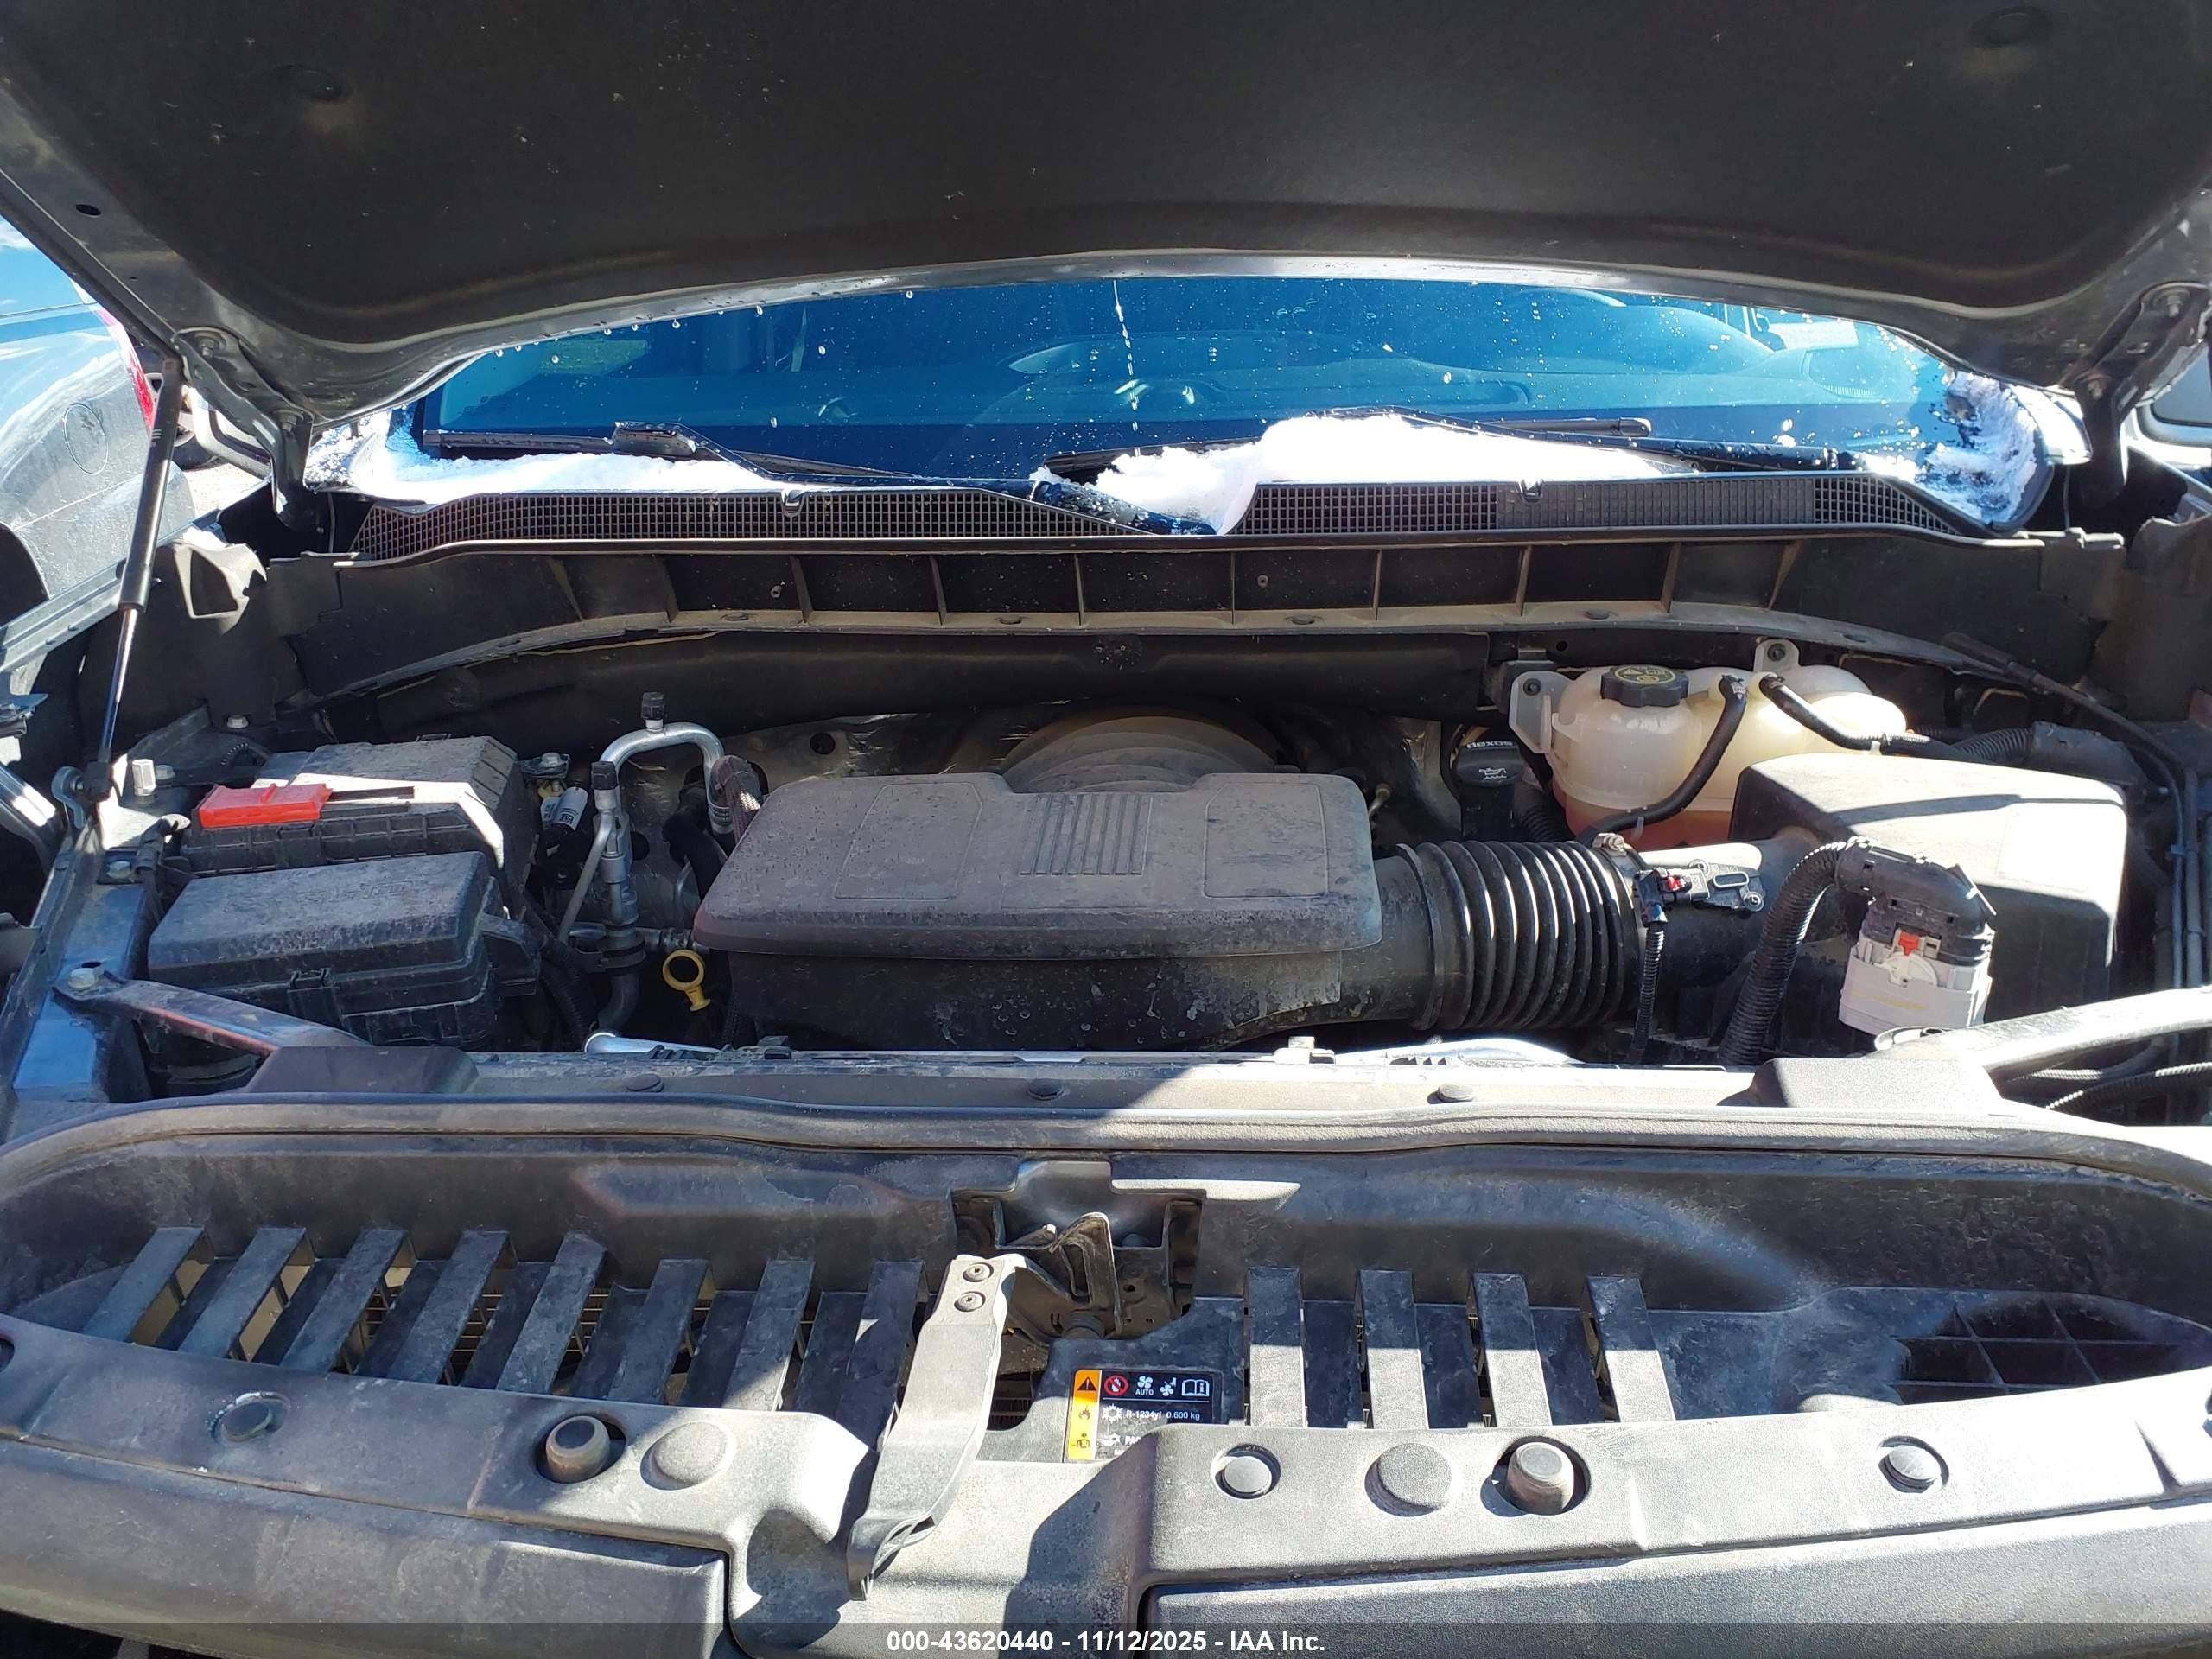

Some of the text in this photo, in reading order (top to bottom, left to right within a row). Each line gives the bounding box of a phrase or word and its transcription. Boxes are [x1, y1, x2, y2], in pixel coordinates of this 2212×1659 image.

[1466, 741, 1513, 749] dexos
[1126, 1410, 1162, 1421] R-1234yf
[1190, 1412, 1200, 1421] kg
